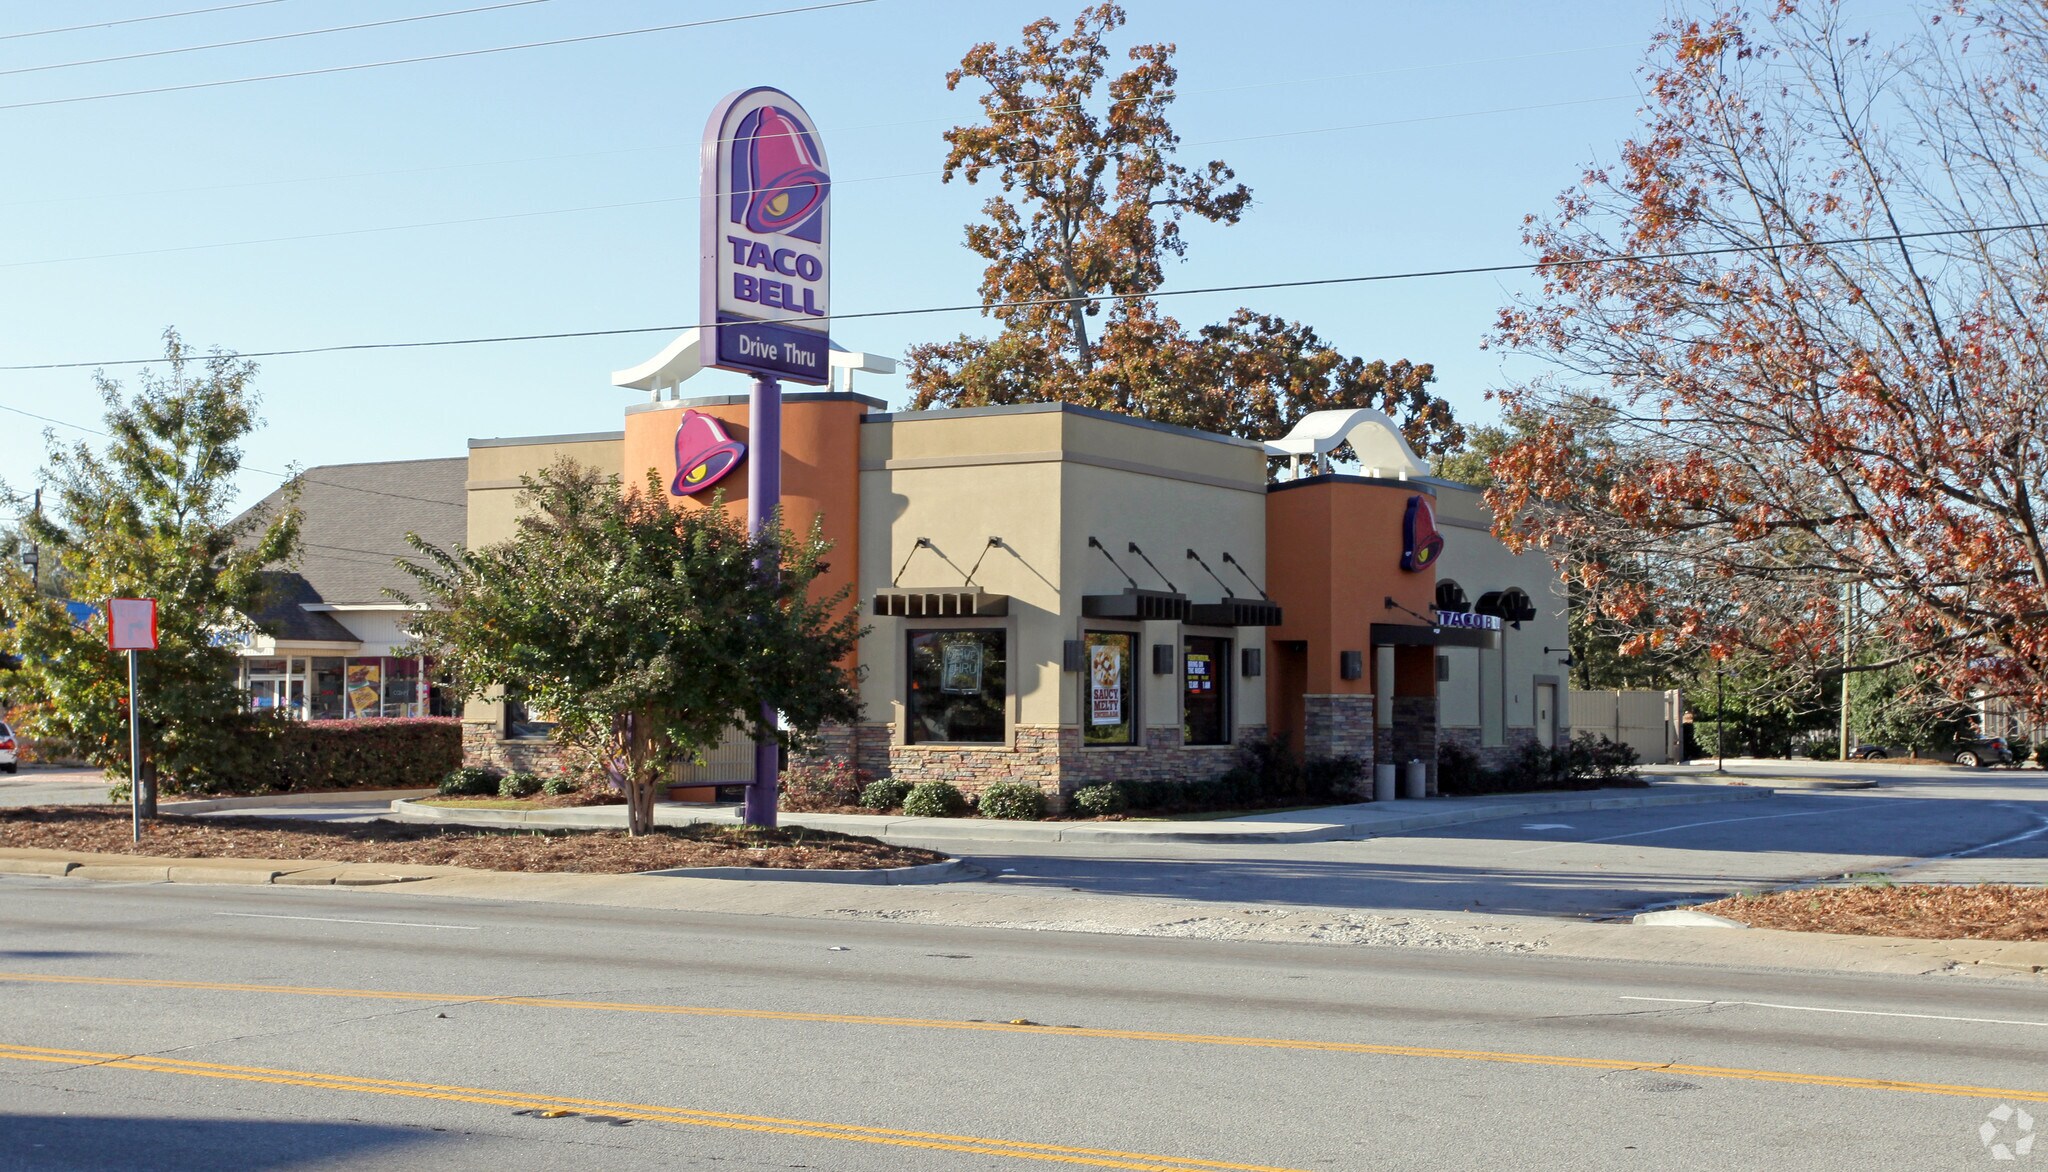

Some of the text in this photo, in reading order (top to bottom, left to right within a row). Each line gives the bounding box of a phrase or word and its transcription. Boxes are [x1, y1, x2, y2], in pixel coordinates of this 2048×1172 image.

[727, 235, 823, 283] TACO
[733, 272, 825, 317] BELL
[739, 334, 816, 368] Drive Thru
[1439, 611, 1483, 629] TACO
[947, 662, 978, 674] THRU
[1093, 688, 1118, 700] SAUCY
[1093, 700, 1118, 711] MELTY
